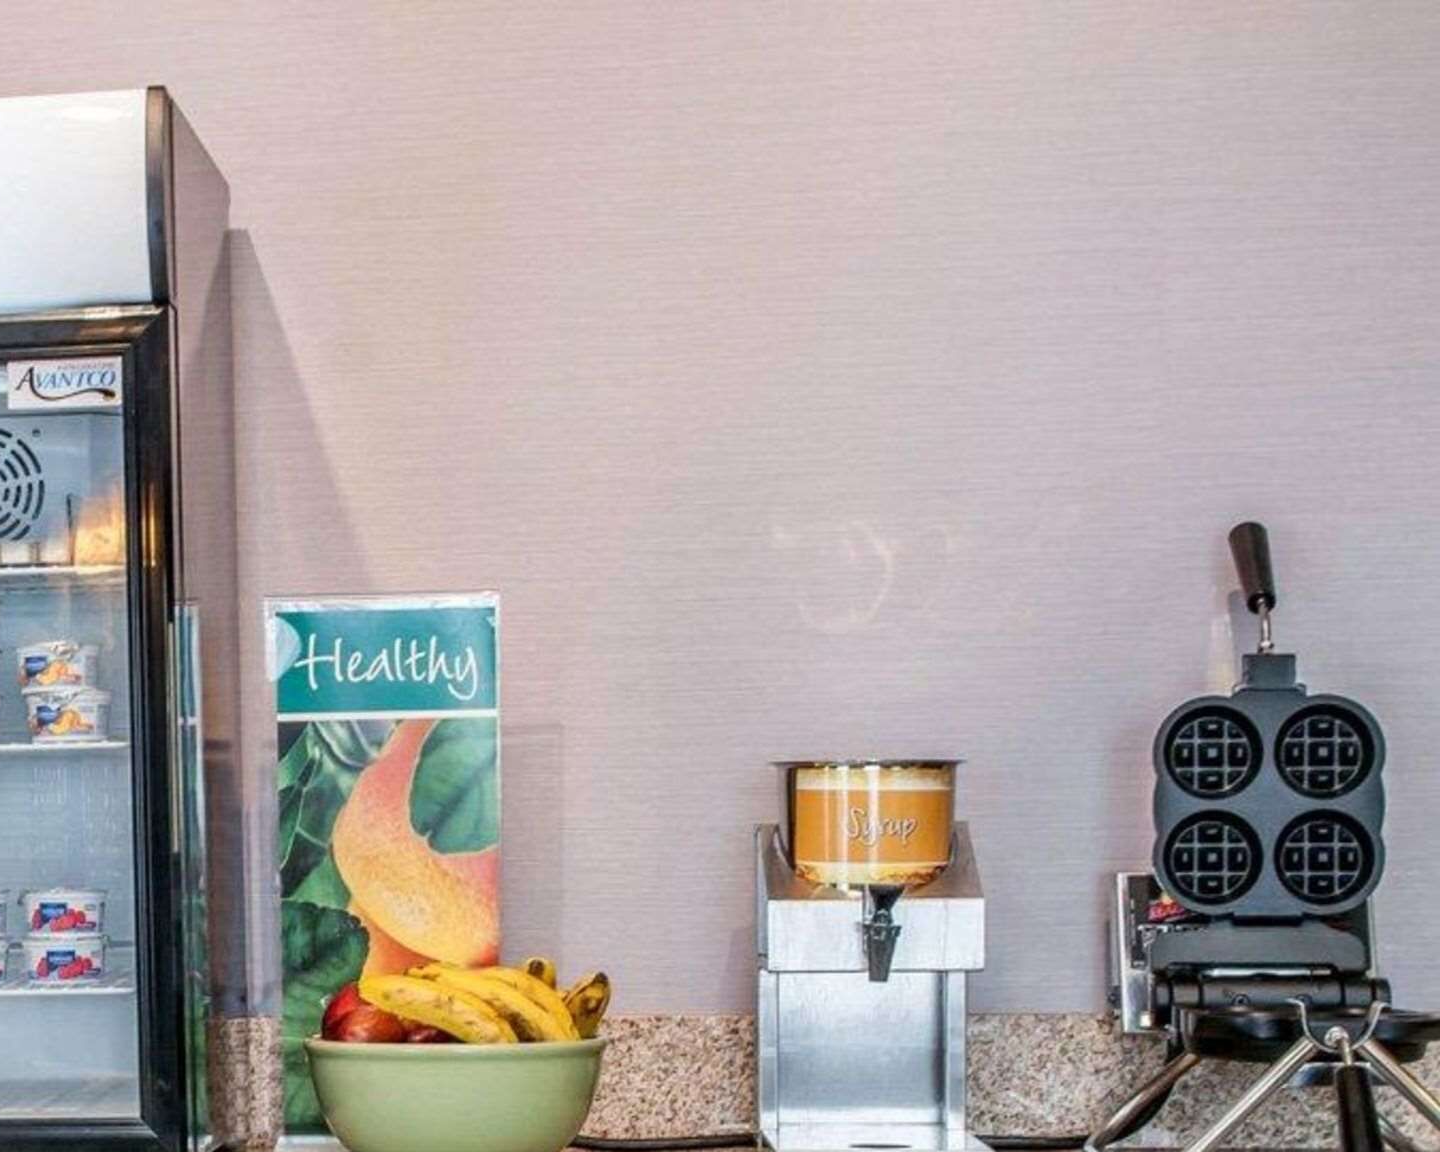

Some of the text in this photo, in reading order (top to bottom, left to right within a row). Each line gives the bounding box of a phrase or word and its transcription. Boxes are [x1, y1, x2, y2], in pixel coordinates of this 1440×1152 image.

[15, 366, 117, 393] AVANTCO
[294, 633, 478, 701] Healthy
[847, 807, 919, 847] Syrup
